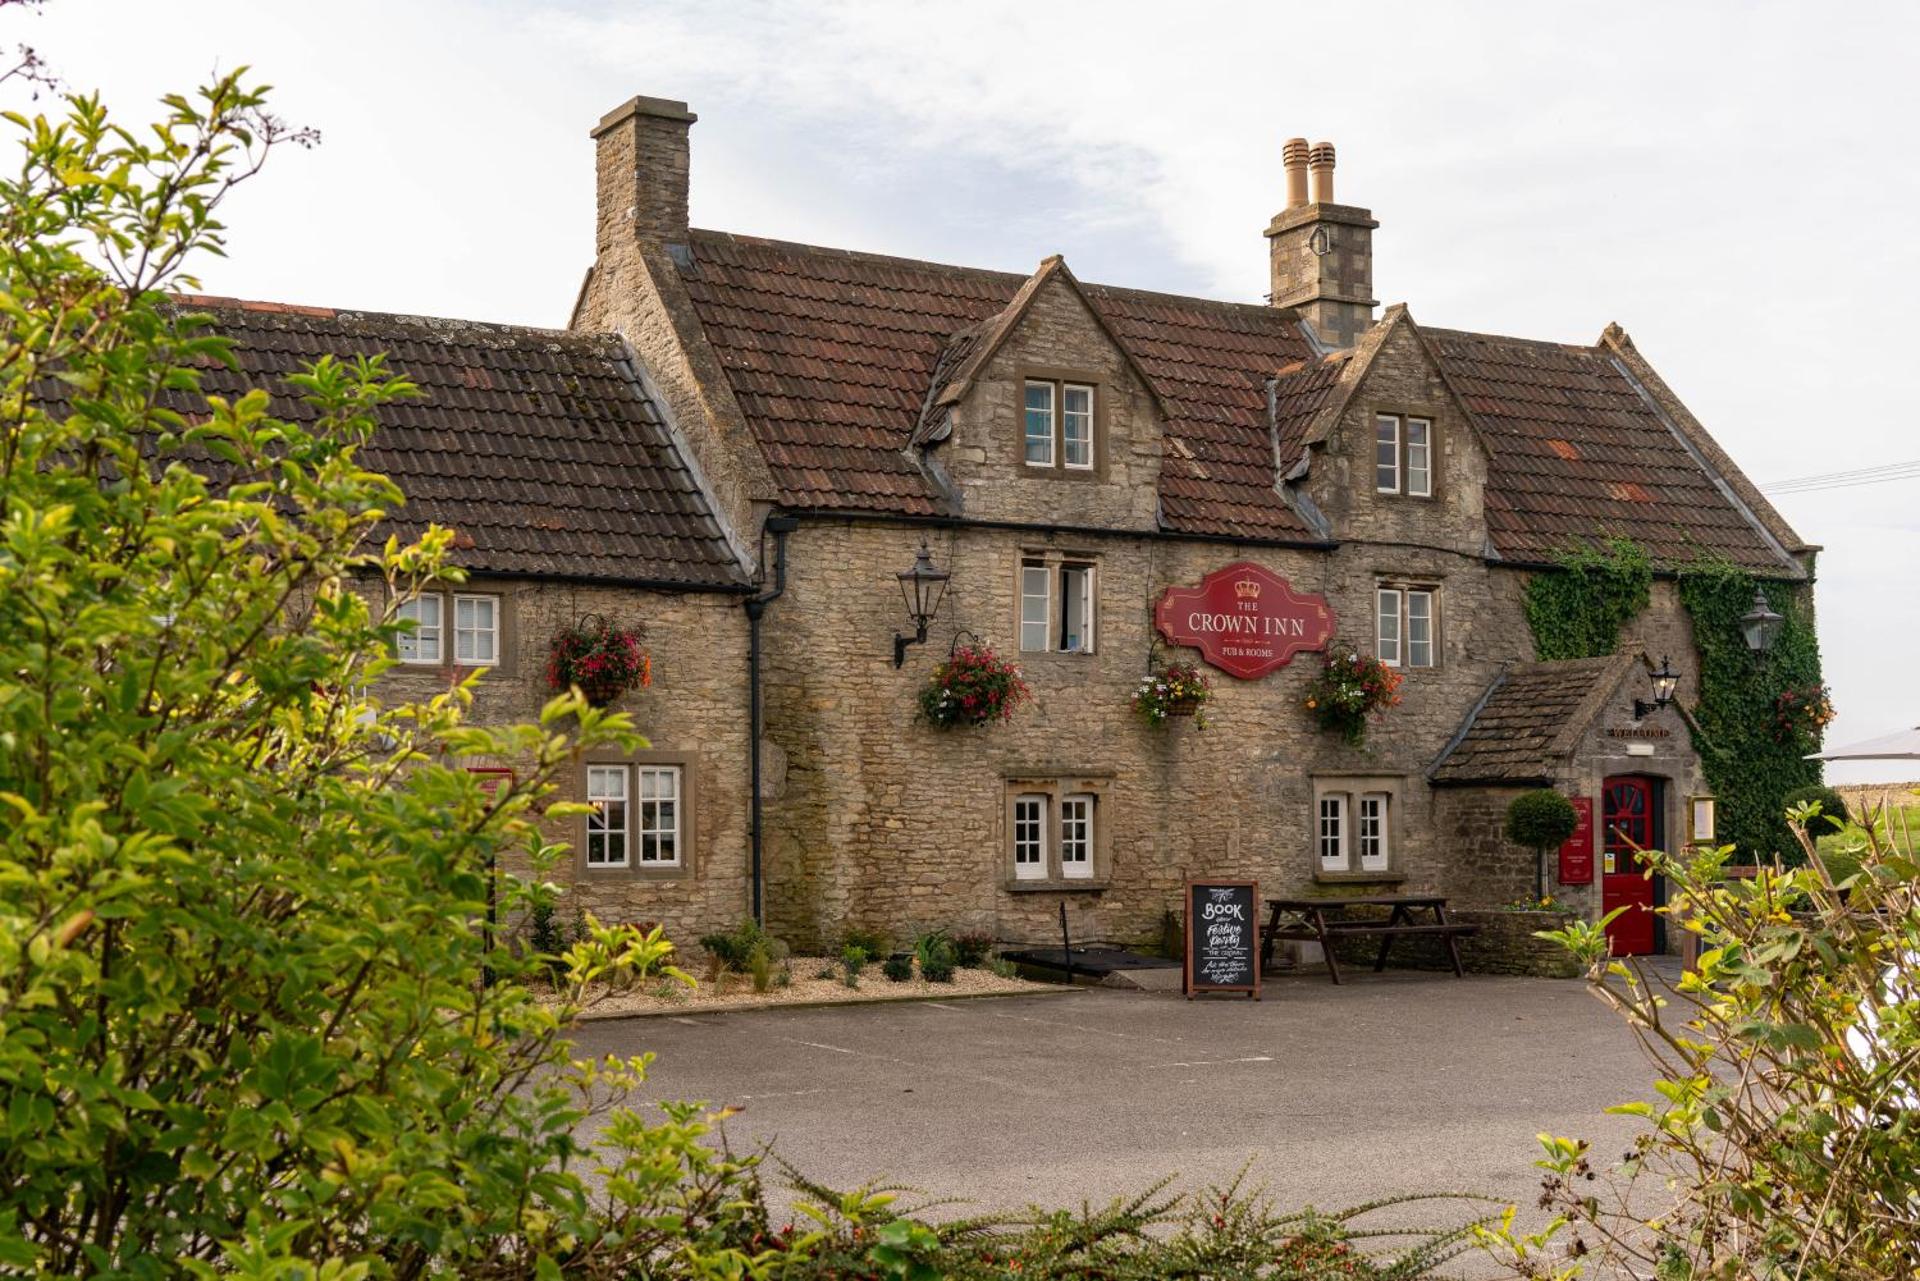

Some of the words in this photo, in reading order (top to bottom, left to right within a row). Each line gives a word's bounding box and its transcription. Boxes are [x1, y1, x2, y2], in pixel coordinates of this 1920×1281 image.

[1237, 602, 1258, 611] THE
[1188, 612, 1257, 634] CROWN
[1264, 617, 1305, 636] INN
[1222, 647, 1237, 656] PUB
[1238, 648, 1244, 656] &
[1246, 648, 1273, 657] ROOMS
[1201, 903, 1244, 920] BOOK
[1207, 923, 1242, 937] Festive
